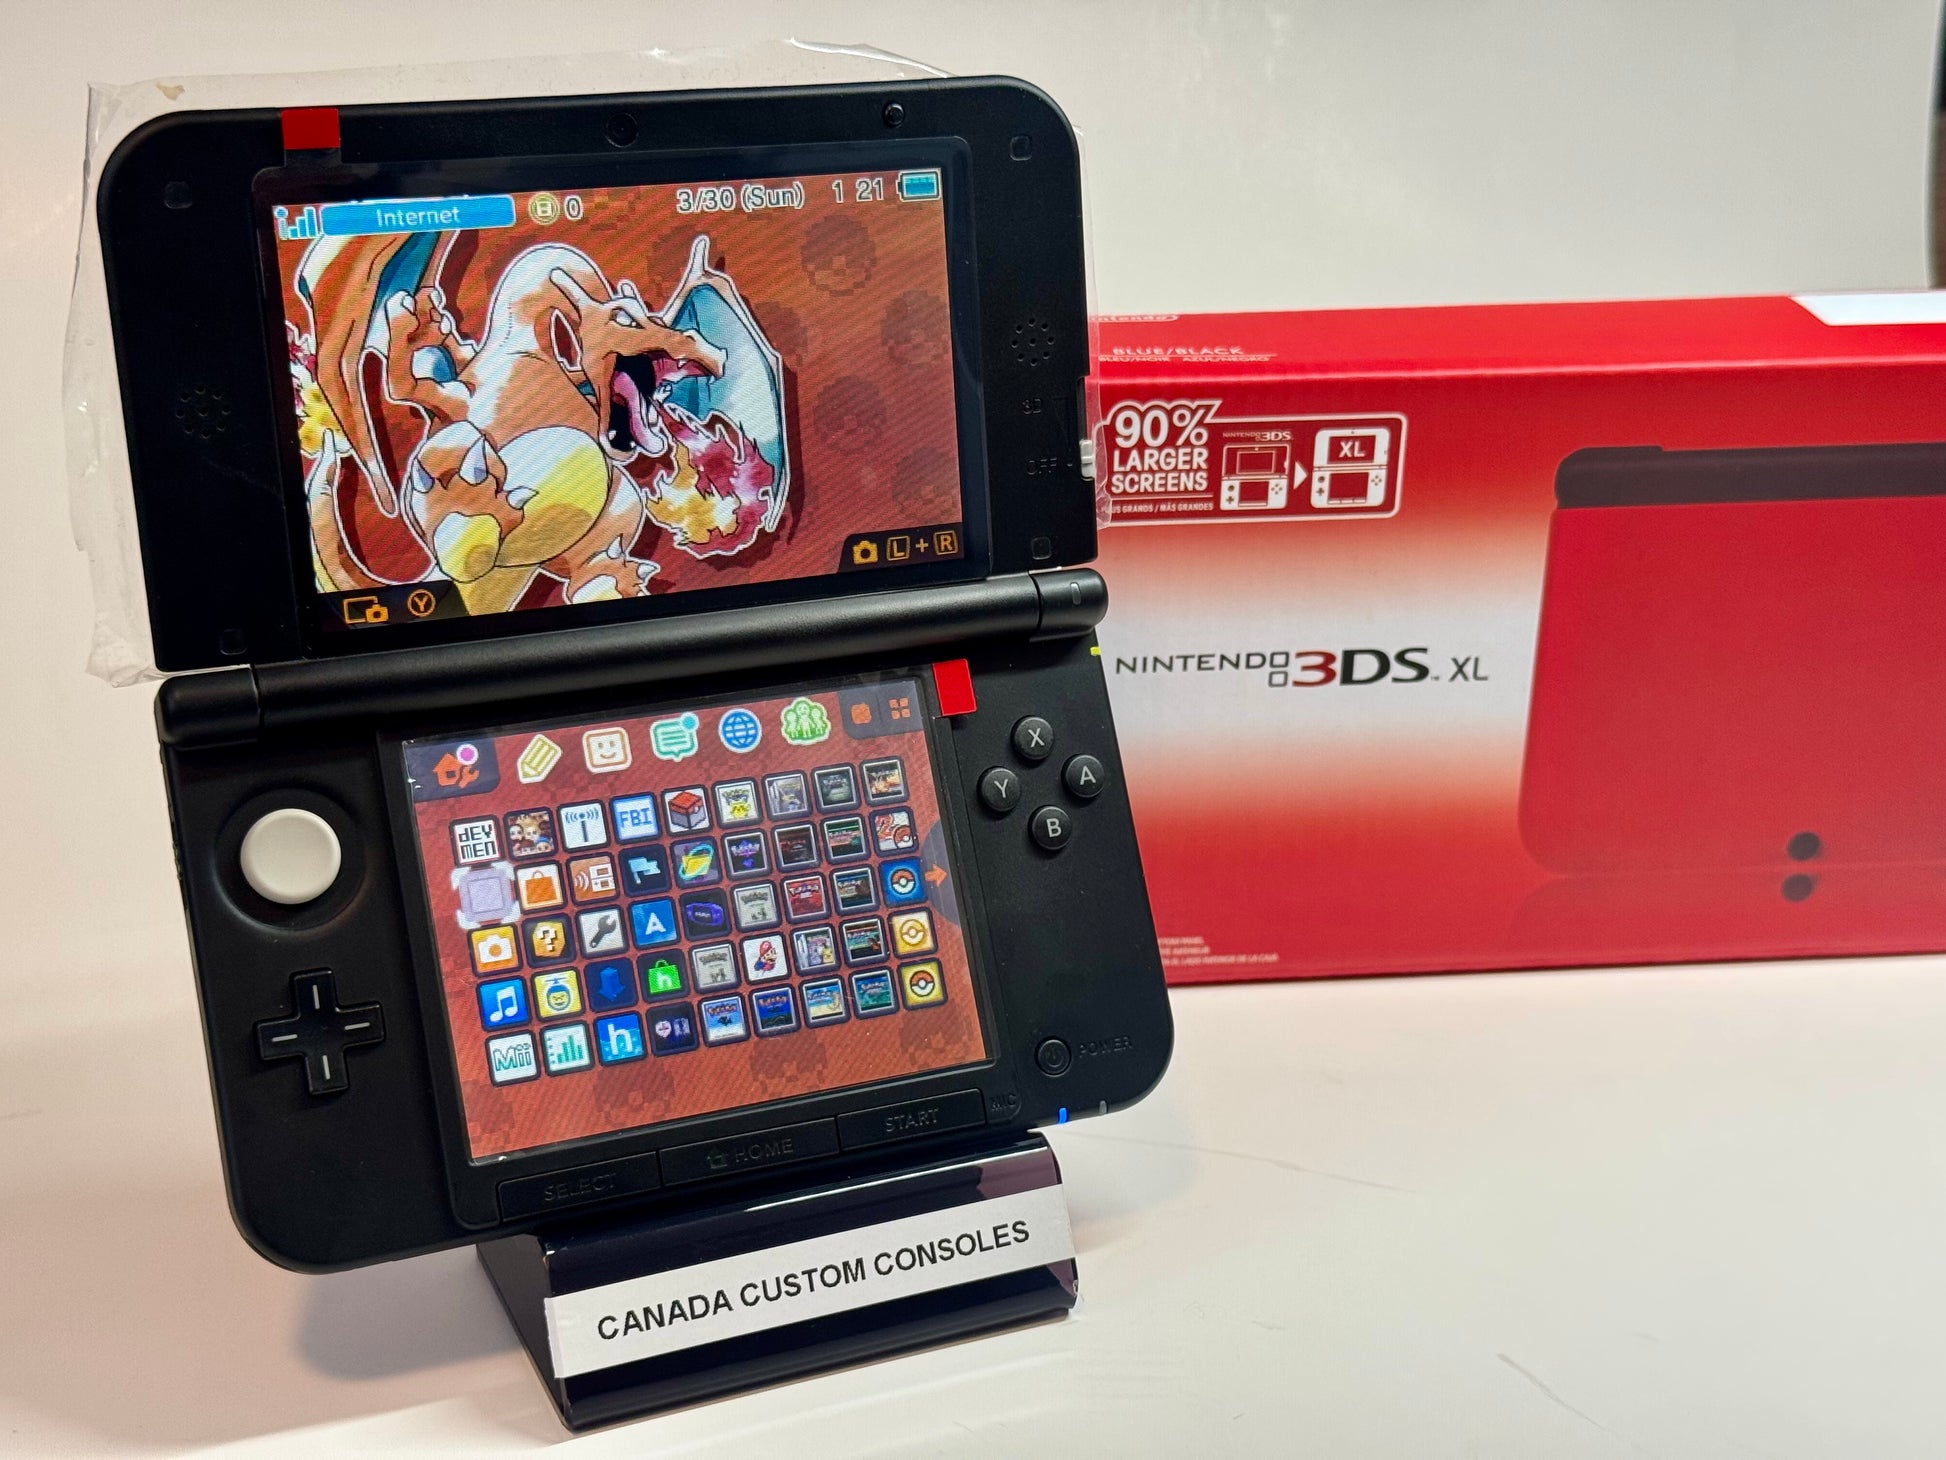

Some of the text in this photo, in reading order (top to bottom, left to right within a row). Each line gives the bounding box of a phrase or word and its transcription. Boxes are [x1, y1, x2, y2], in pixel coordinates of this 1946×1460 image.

[564, 195, 584, 220] 0
[677, 187, 734, 213] 3/30
[741, 181, 805, 212] (Sun)
[376, 207, 460, 228] Internet
[1112, 345, 1245, 356] BLUE/BLACK
[1115, 409, 1208, 448] 90%
[1261, 431, 1292, 442] 3DS
[1113, 447, 1208, 472] LARGER
[1338, 440, 1366, 458] XL
[1111, 470, 1208, 494] SCREENS
[1177, 502, 1214, 512] GRANDES
[1291, 647, 1430, 687] 3DS
[1447, 656, 1489, 683] XL
[1028, 727, 1046, 749] X
[1078, 764, 1098, 787] A
[993, 779, 1011, 799] Y
[619, 807, 651, 828] FBI
[1046, 817, 1063, 838] B
[645, 911, 667, 936] A
[608, 1023, 632, 1055] h
[884, 1107, 940, 1134] START
[735, 1137, 794, 1166] HOME
[542, 1171, 617, 1203] SELECT
[597, 1219, 1031, 1341] CANADA CUSTOM CONSOLES
